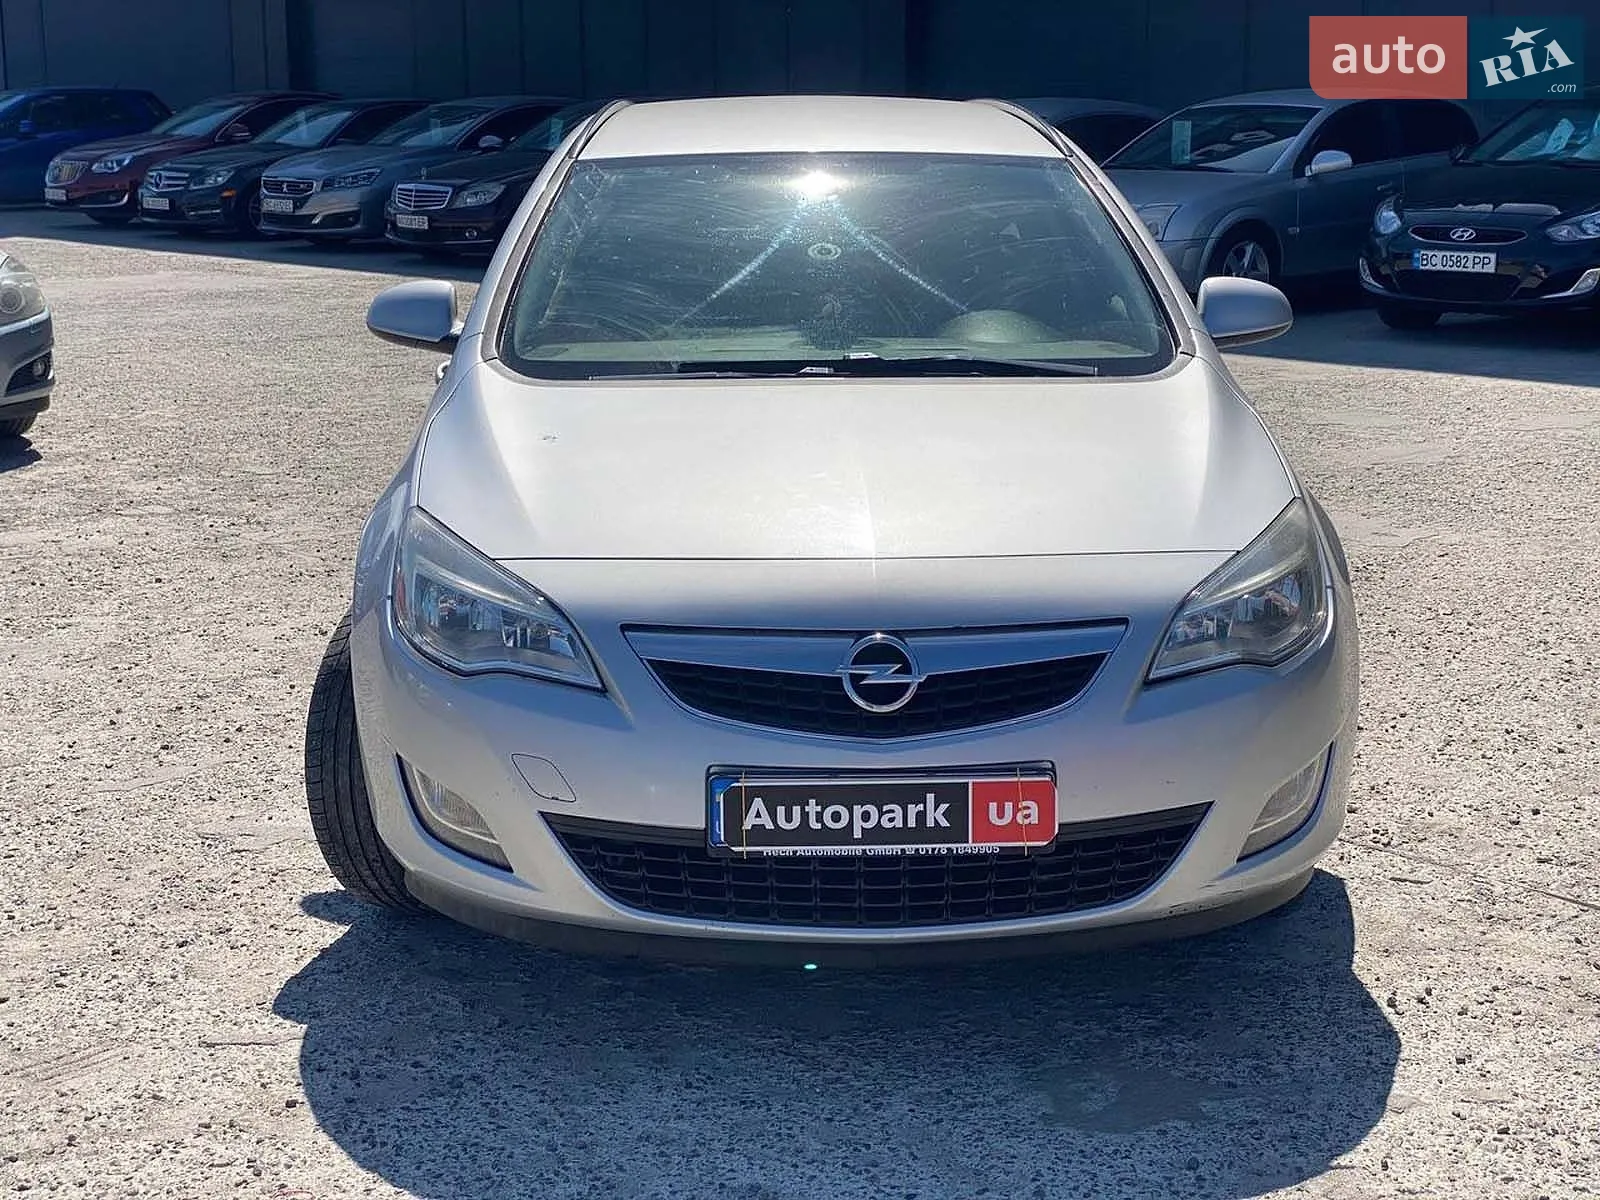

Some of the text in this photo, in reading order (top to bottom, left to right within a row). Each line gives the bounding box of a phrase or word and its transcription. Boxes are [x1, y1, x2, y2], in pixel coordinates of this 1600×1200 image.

[1420, 252, 1491, 270] BC 0582 PP
[742, 793, 1039, 839] Autopark ua
